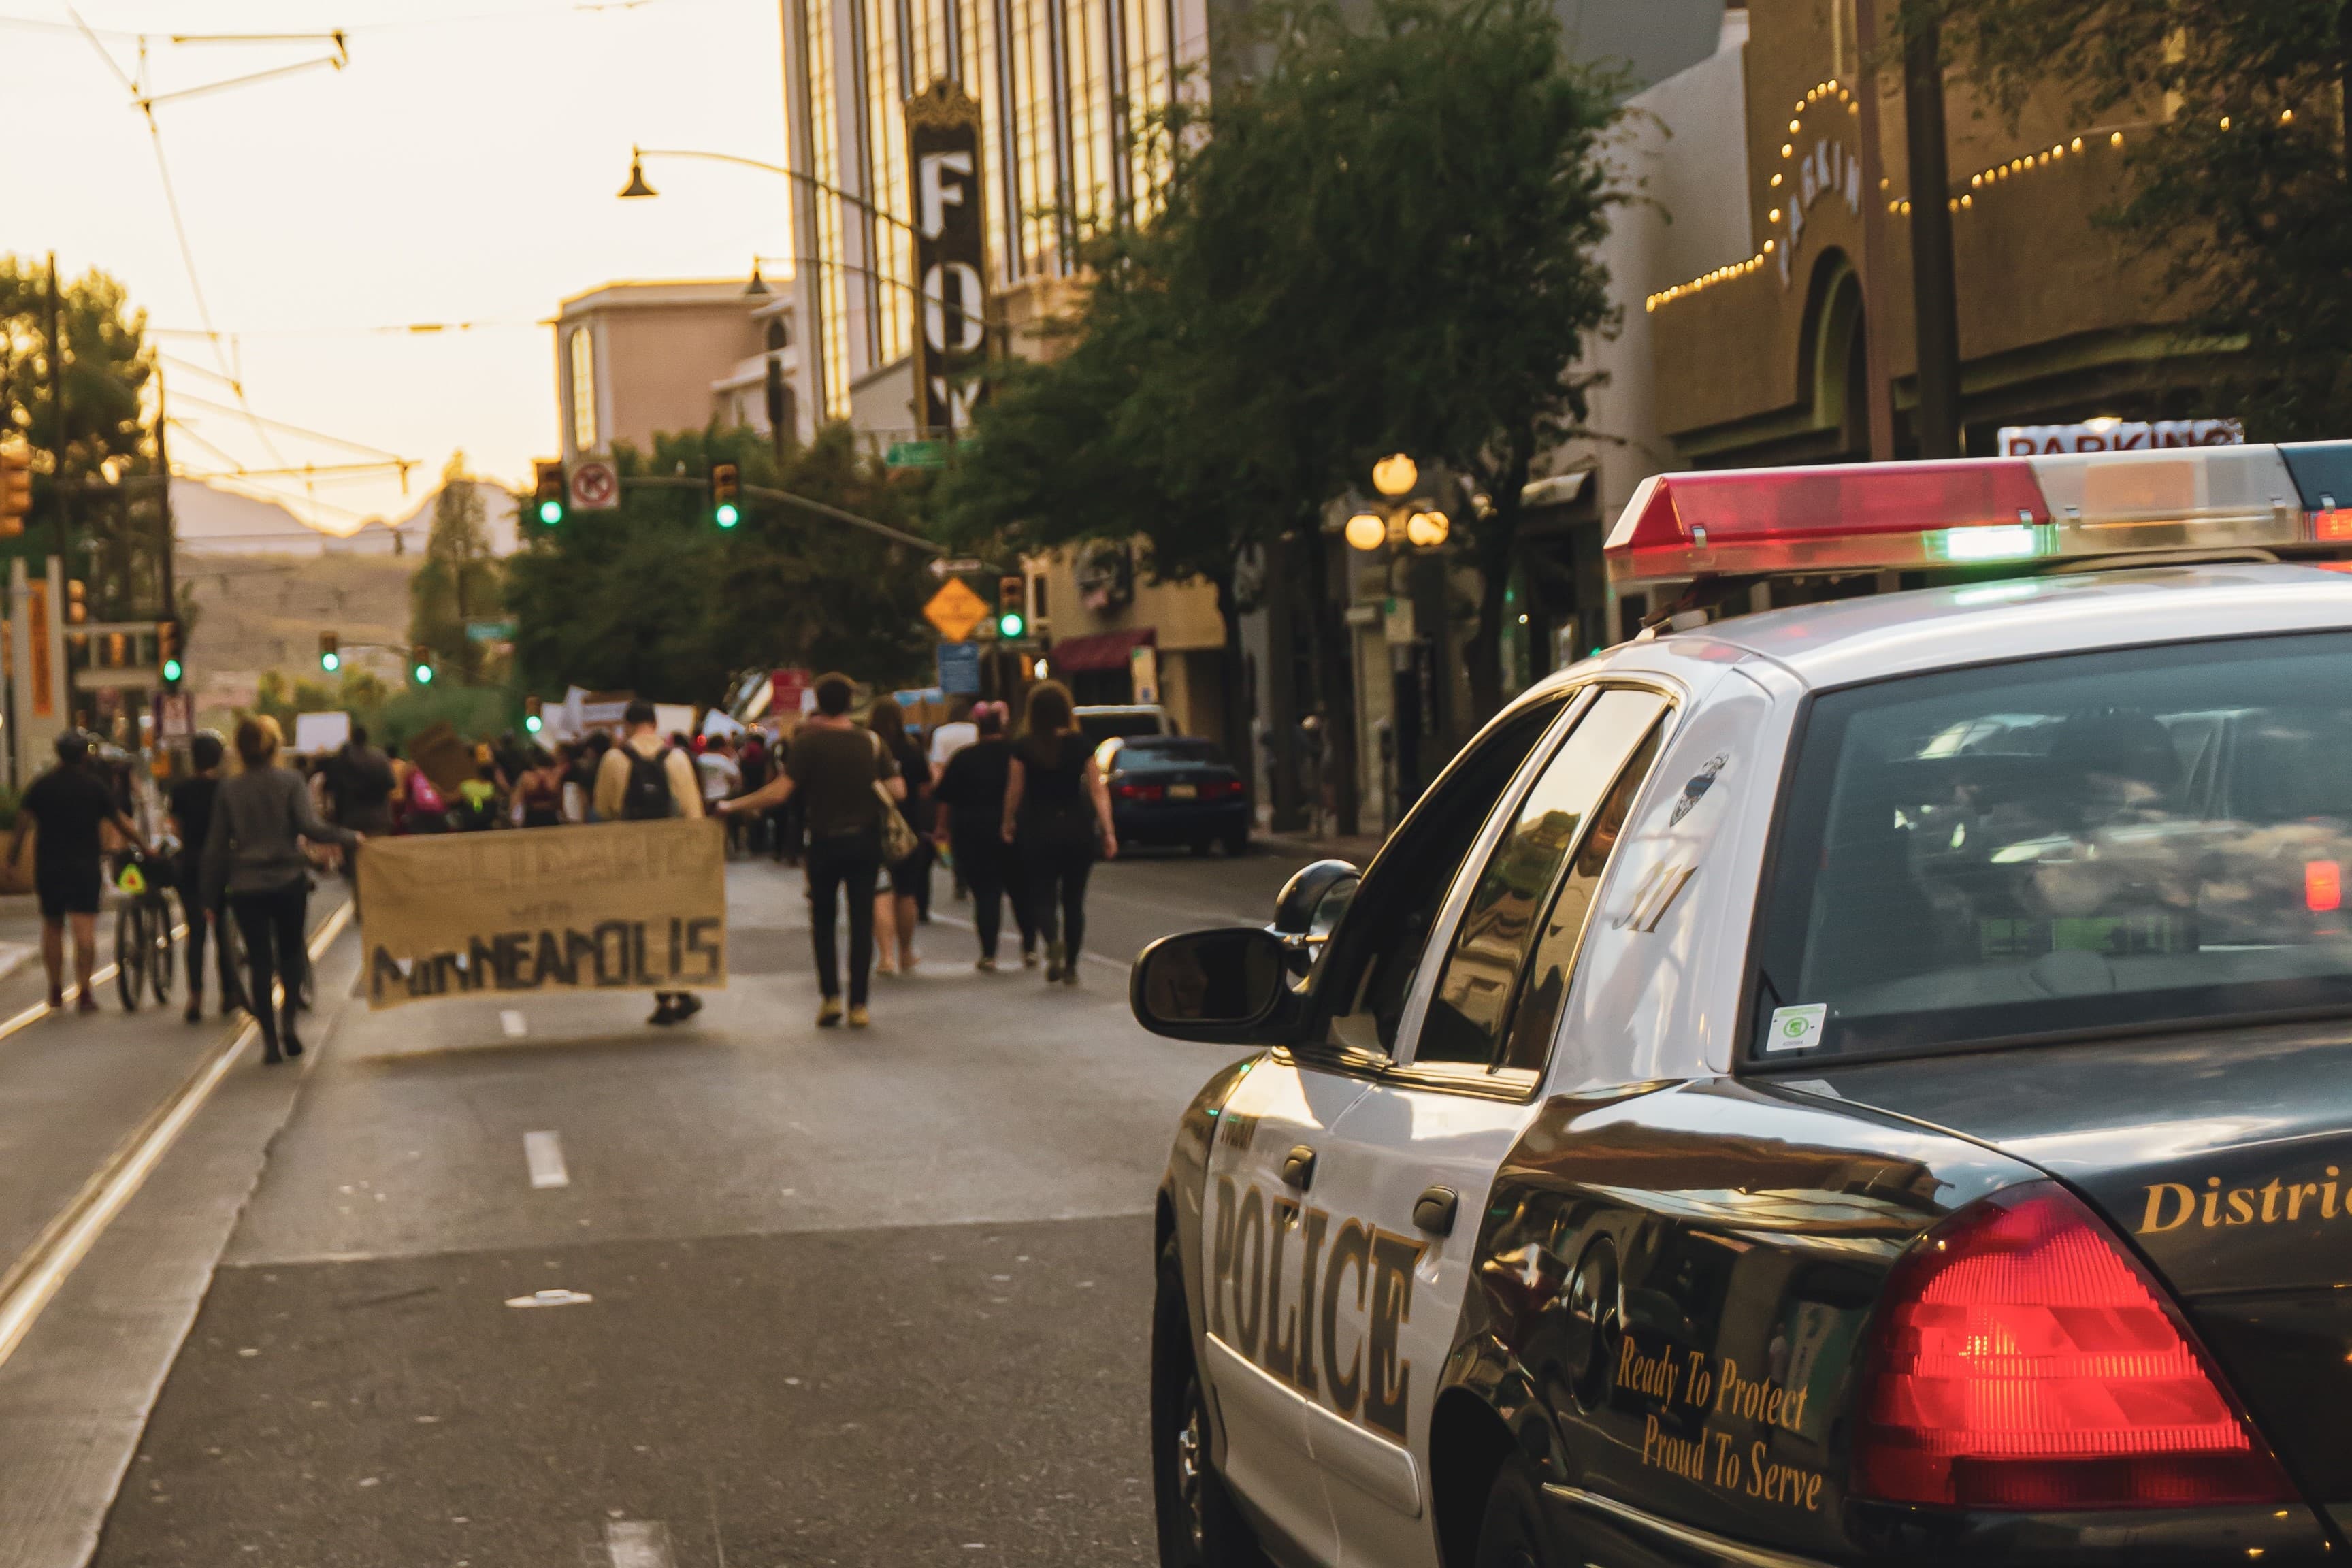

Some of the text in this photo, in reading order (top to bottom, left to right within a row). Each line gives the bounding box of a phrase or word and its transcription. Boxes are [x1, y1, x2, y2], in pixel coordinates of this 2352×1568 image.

[1611, 860, 1699, 934] 311
[2134, 1165, 2352, 1235] Distri
[1213, 1175, 1429, 1446] POLICE
[1616, 1335, 1808, 1430] Ready To Protect
[1642, 1414, 1823, 1512] Proud To Serve
